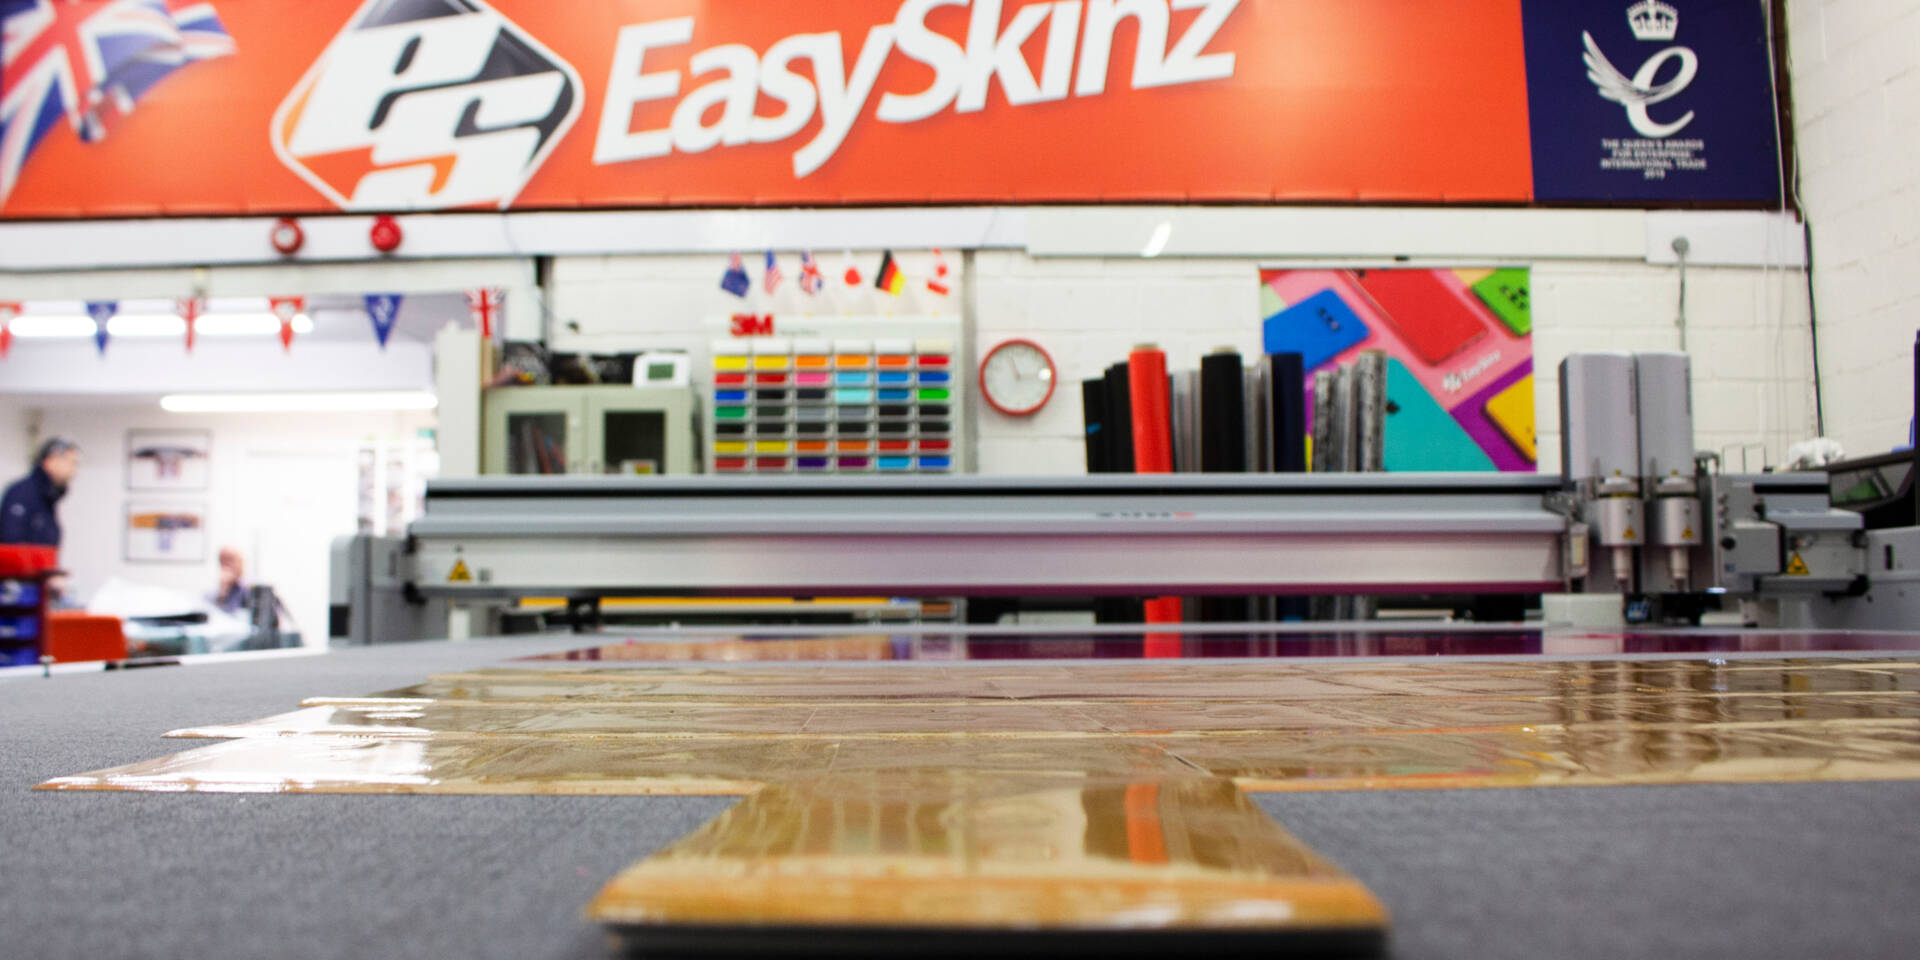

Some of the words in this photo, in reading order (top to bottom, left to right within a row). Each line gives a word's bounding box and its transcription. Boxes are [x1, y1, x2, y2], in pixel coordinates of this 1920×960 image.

[591, 0, 1240, 179] EasySkinz
[1601, 139, 1619, 149] THE
[1622, 139, 1663, 150] QUEEN'S
[1664, 139, 1704, 150] AWARDS
[1612, 149, 1632, 159] FOR
[1600, 159, 1674, 170] INTERNATIONAL
[1676, 159, 1706, 170] TRADE
[730, 313, 774, 336] 3M
